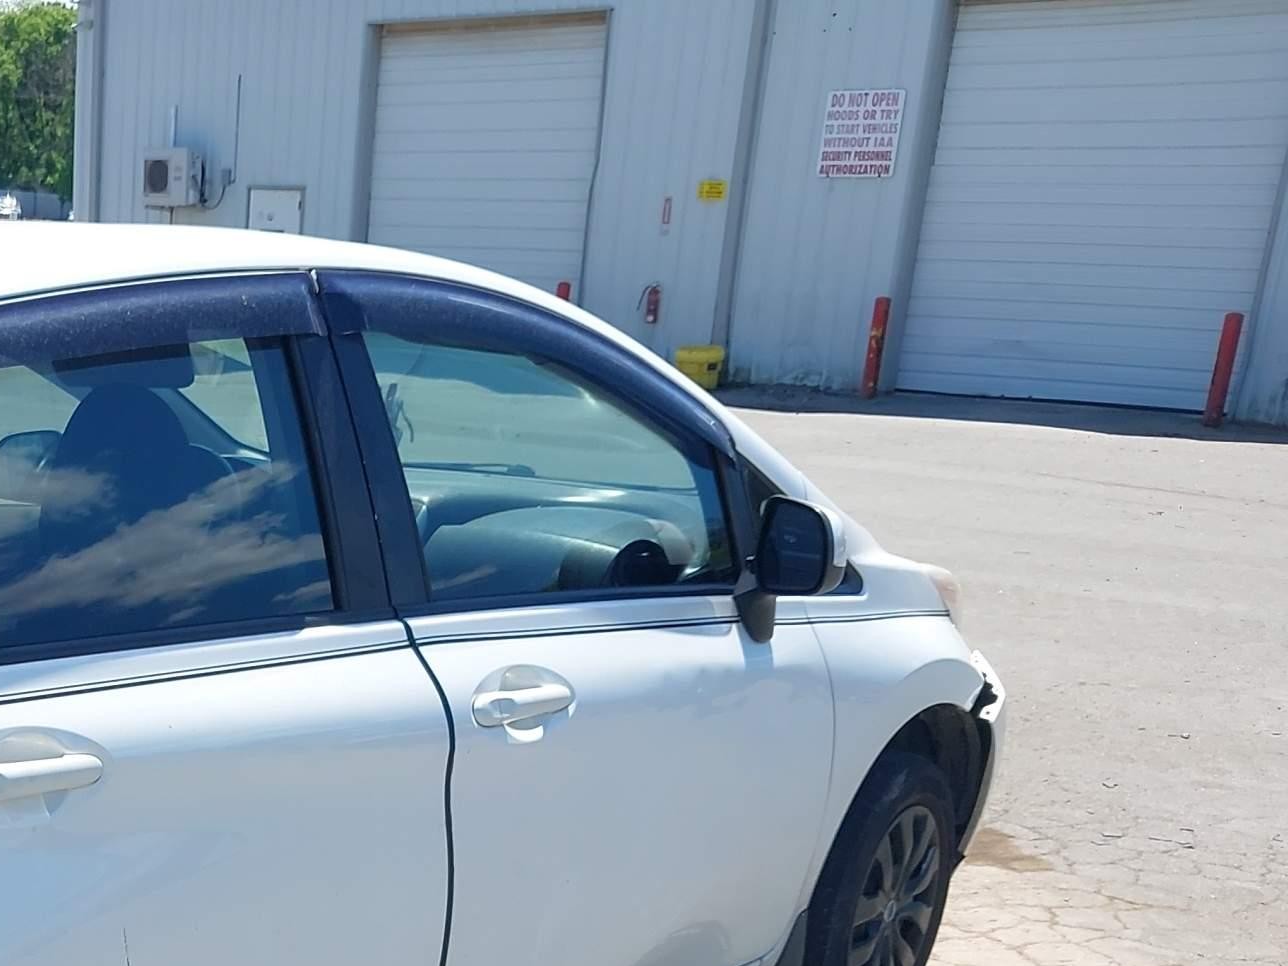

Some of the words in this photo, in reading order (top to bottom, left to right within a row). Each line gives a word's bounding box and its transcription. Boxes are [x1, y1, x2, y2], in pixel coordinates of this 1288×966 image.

[831, 94, 845, 108] DO
[848, 93, 869, 107] NOT
[872, 92, 899, 107] OPEN
[827, 110, 859, 120] HOODS
[863, 109, 877, 120] OR
[880, 109, 899, 120] TRY
[825, 123, 834, 135] TO
[836, 123, 860, 135] START
[862, 123, 898, 134] VEHICLES
[823, 136, 871, 148] WITHOUT
[873, 136, 893, 147] IAA
[821, 151, 852, 161] SECURITY
[853, 151, 892, 161] PERSONNEL
[819, 164, 890, 175] AUTHORIZATION
